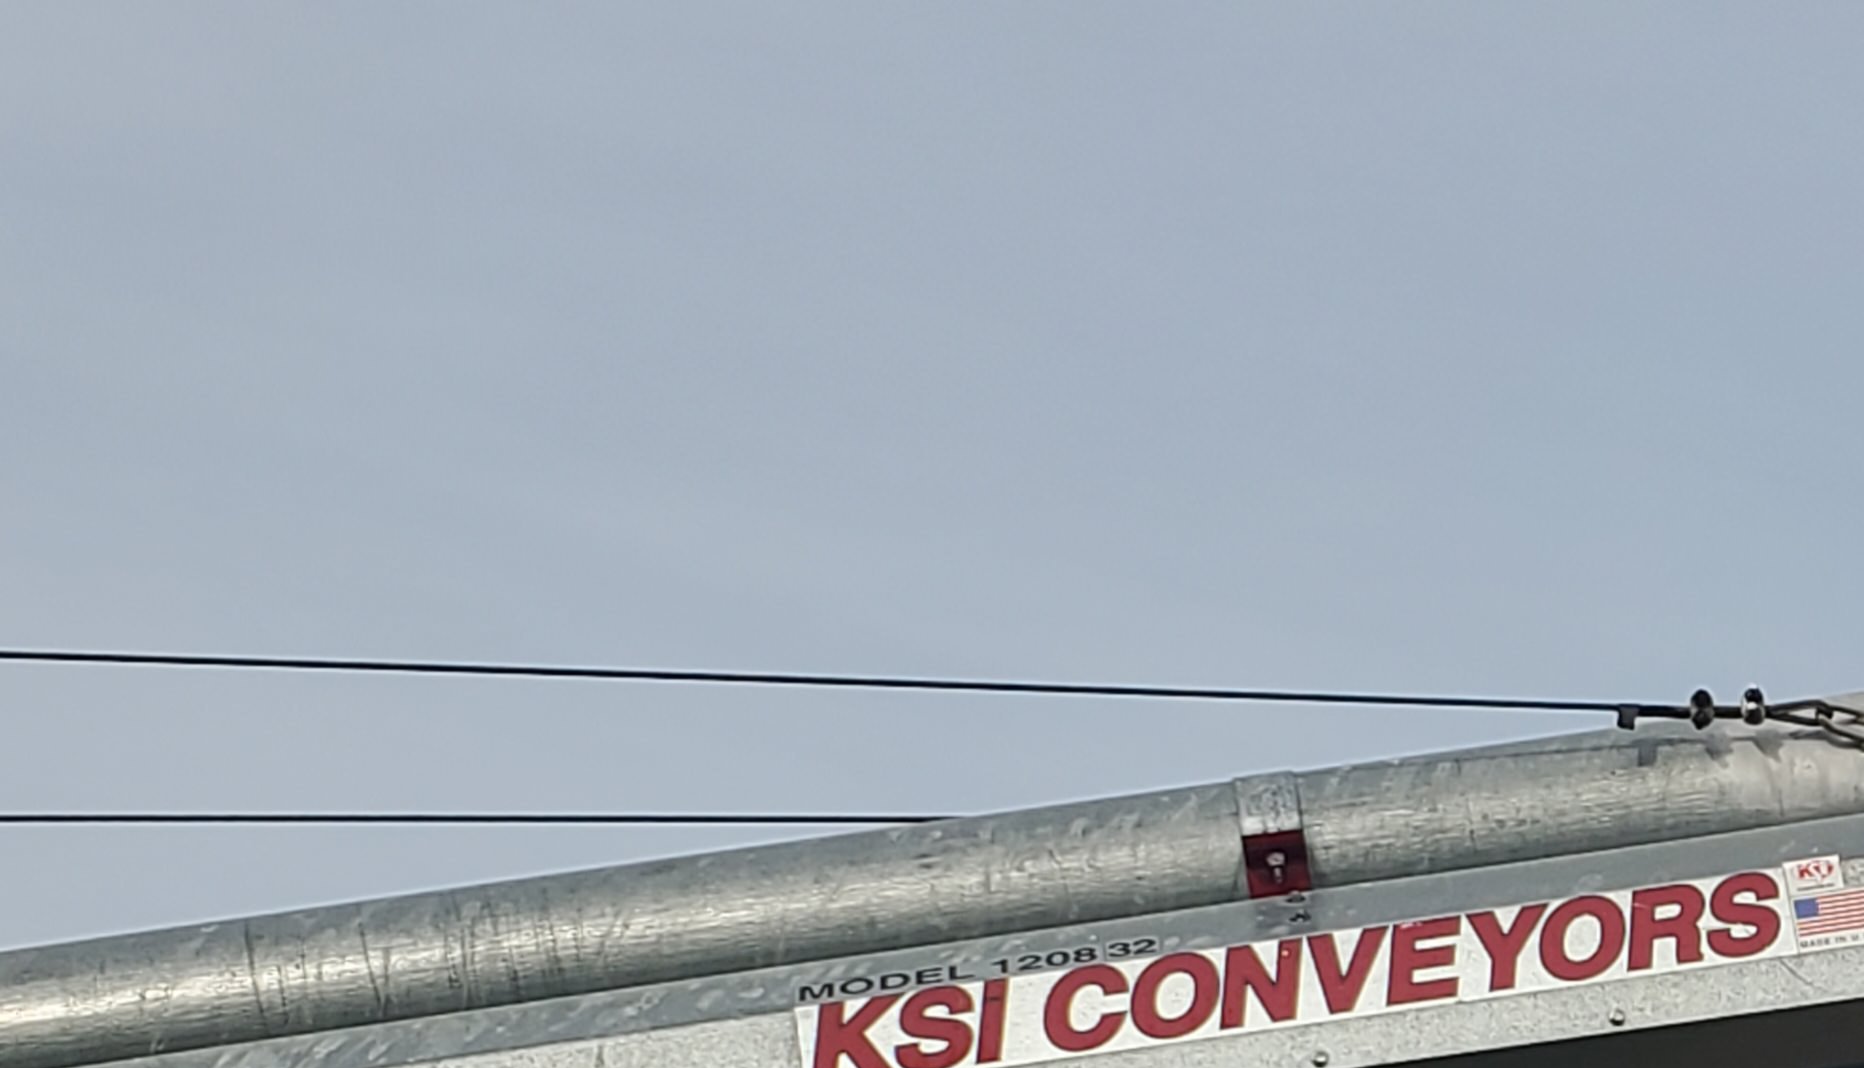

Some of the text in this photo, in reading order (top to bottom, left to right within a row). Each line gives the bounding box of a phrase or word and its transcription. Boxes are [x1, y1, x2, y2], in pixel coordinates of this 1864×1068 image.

[799, 938, 1158, 1002] MODEL 1208 32
[1043, 871, 1781, 1052] CONVEYORS
